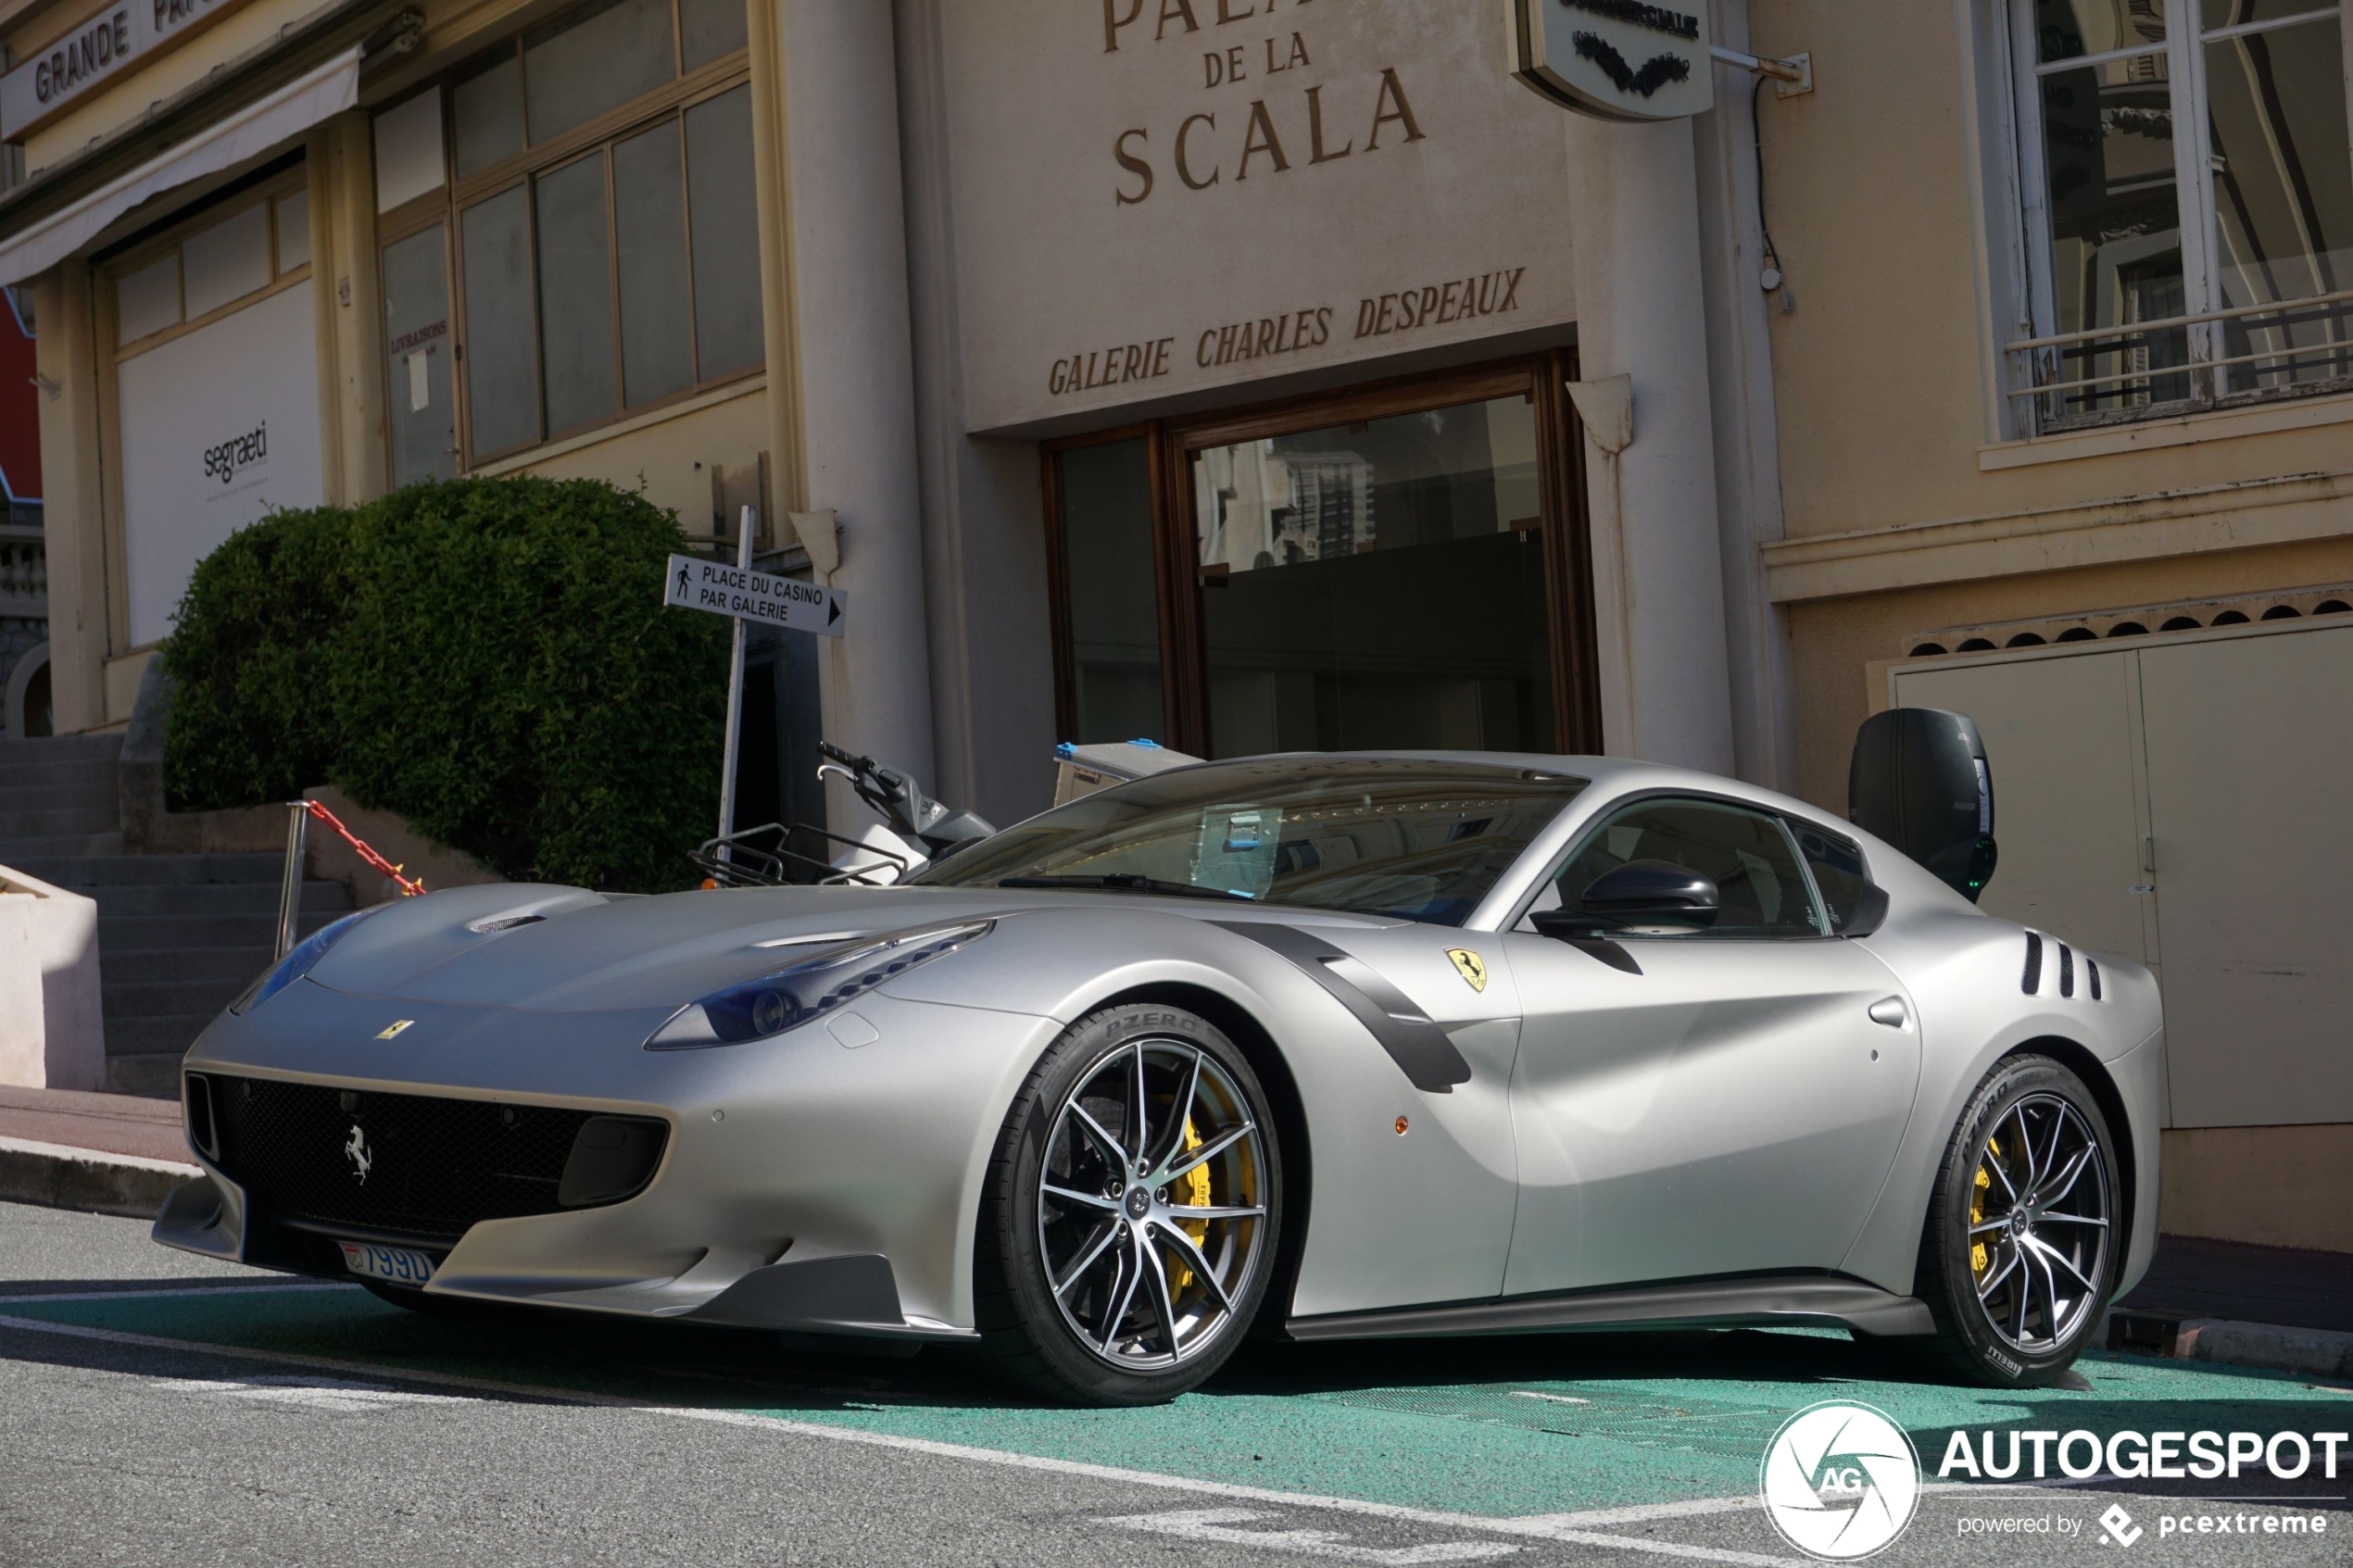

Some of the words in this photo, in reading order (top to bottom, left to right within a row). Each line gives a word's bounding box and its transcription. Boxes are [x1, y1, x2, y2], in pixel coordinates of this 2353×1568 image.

[35, 8, 130, 104] GRANDE
[1203, 45, 1246, 89] DE
[1265, 31, 1311, 74] LA
[1114, 68, 1427, 207] SCALA
[390, 320, 447, 355] LIVRAISONS
[1049, 337, 1174, 395] GALERIE
[1196, 307, 1332, 369] CHARLES
[1354, 268, 1526, 339] DESPEAUX
[700, 588, 726, 608] PAR
[732, 595, 788, 621] GALERIE
[703, 566, 747, 589] PLACE
[751, 576, 769, 594] DU
[774, 582, 823, 606] CASINO
